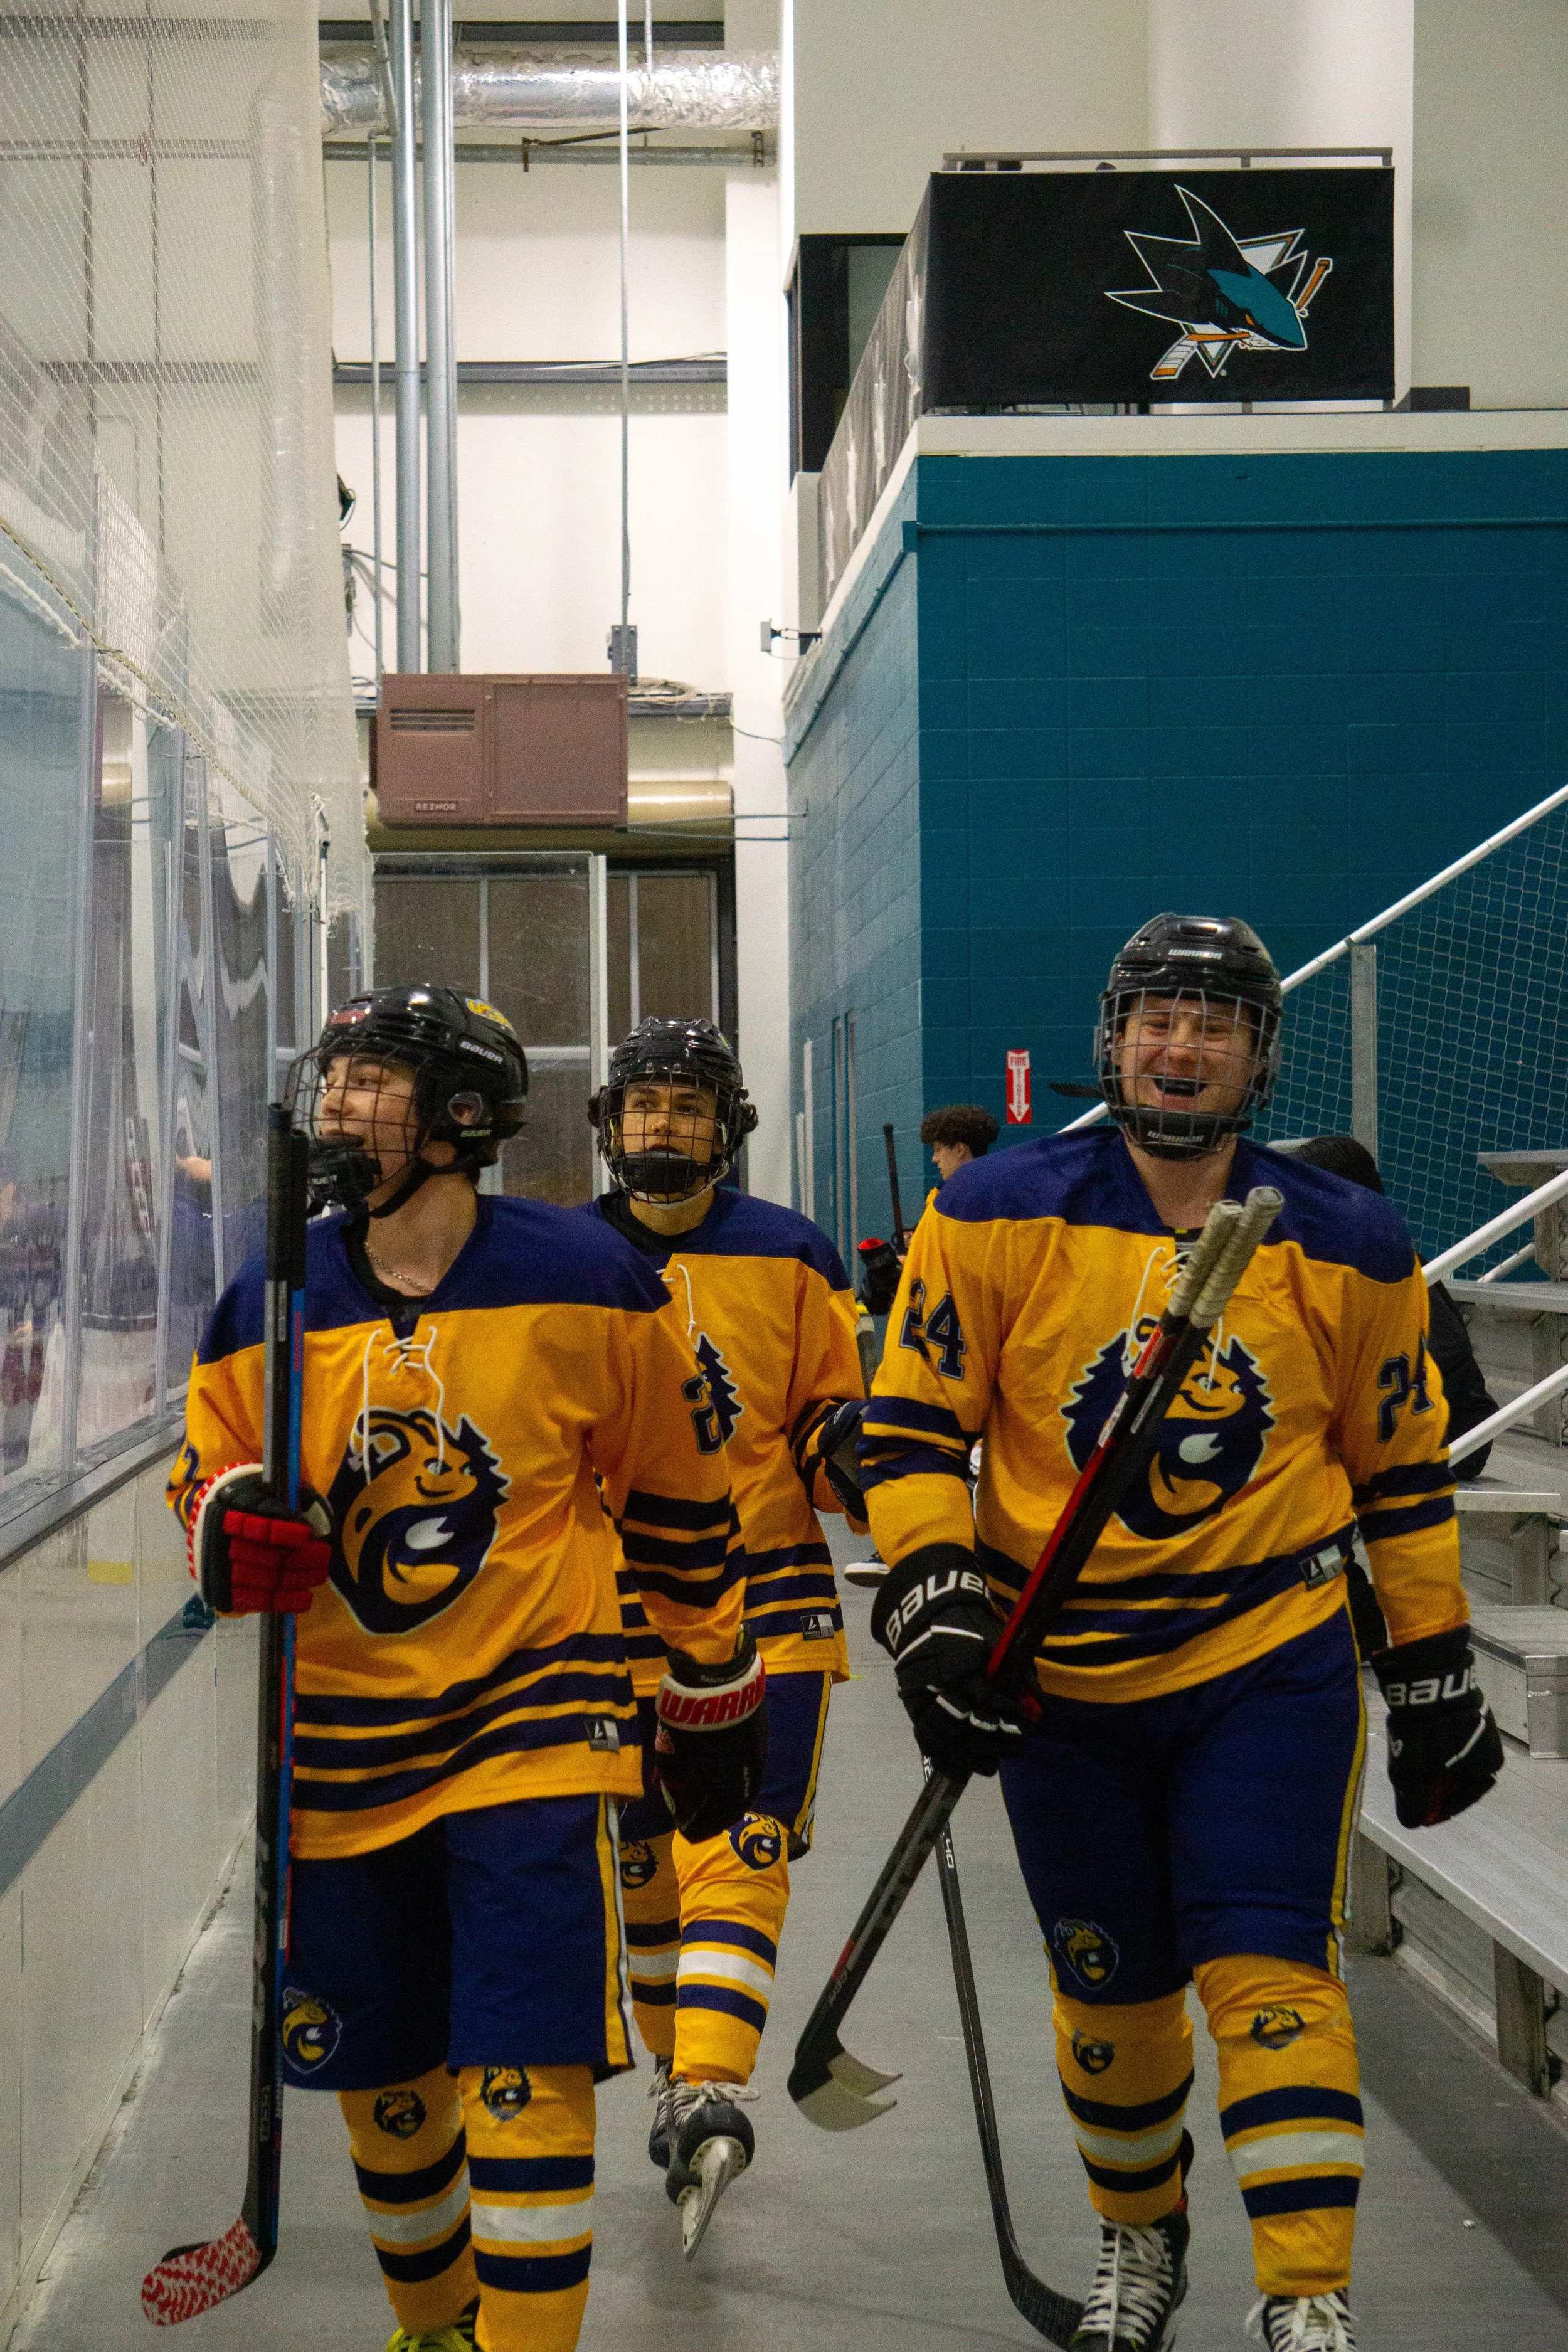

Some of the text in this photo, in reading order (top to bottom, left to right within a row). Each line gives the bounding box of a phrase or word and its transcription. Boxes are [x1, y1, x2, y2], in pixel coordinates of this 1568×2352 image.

[460, 1041, 503, 1064] BAUER
[899, 1278, 966, 1381] 24
[886, 1570, 990, 1651] BAUE
